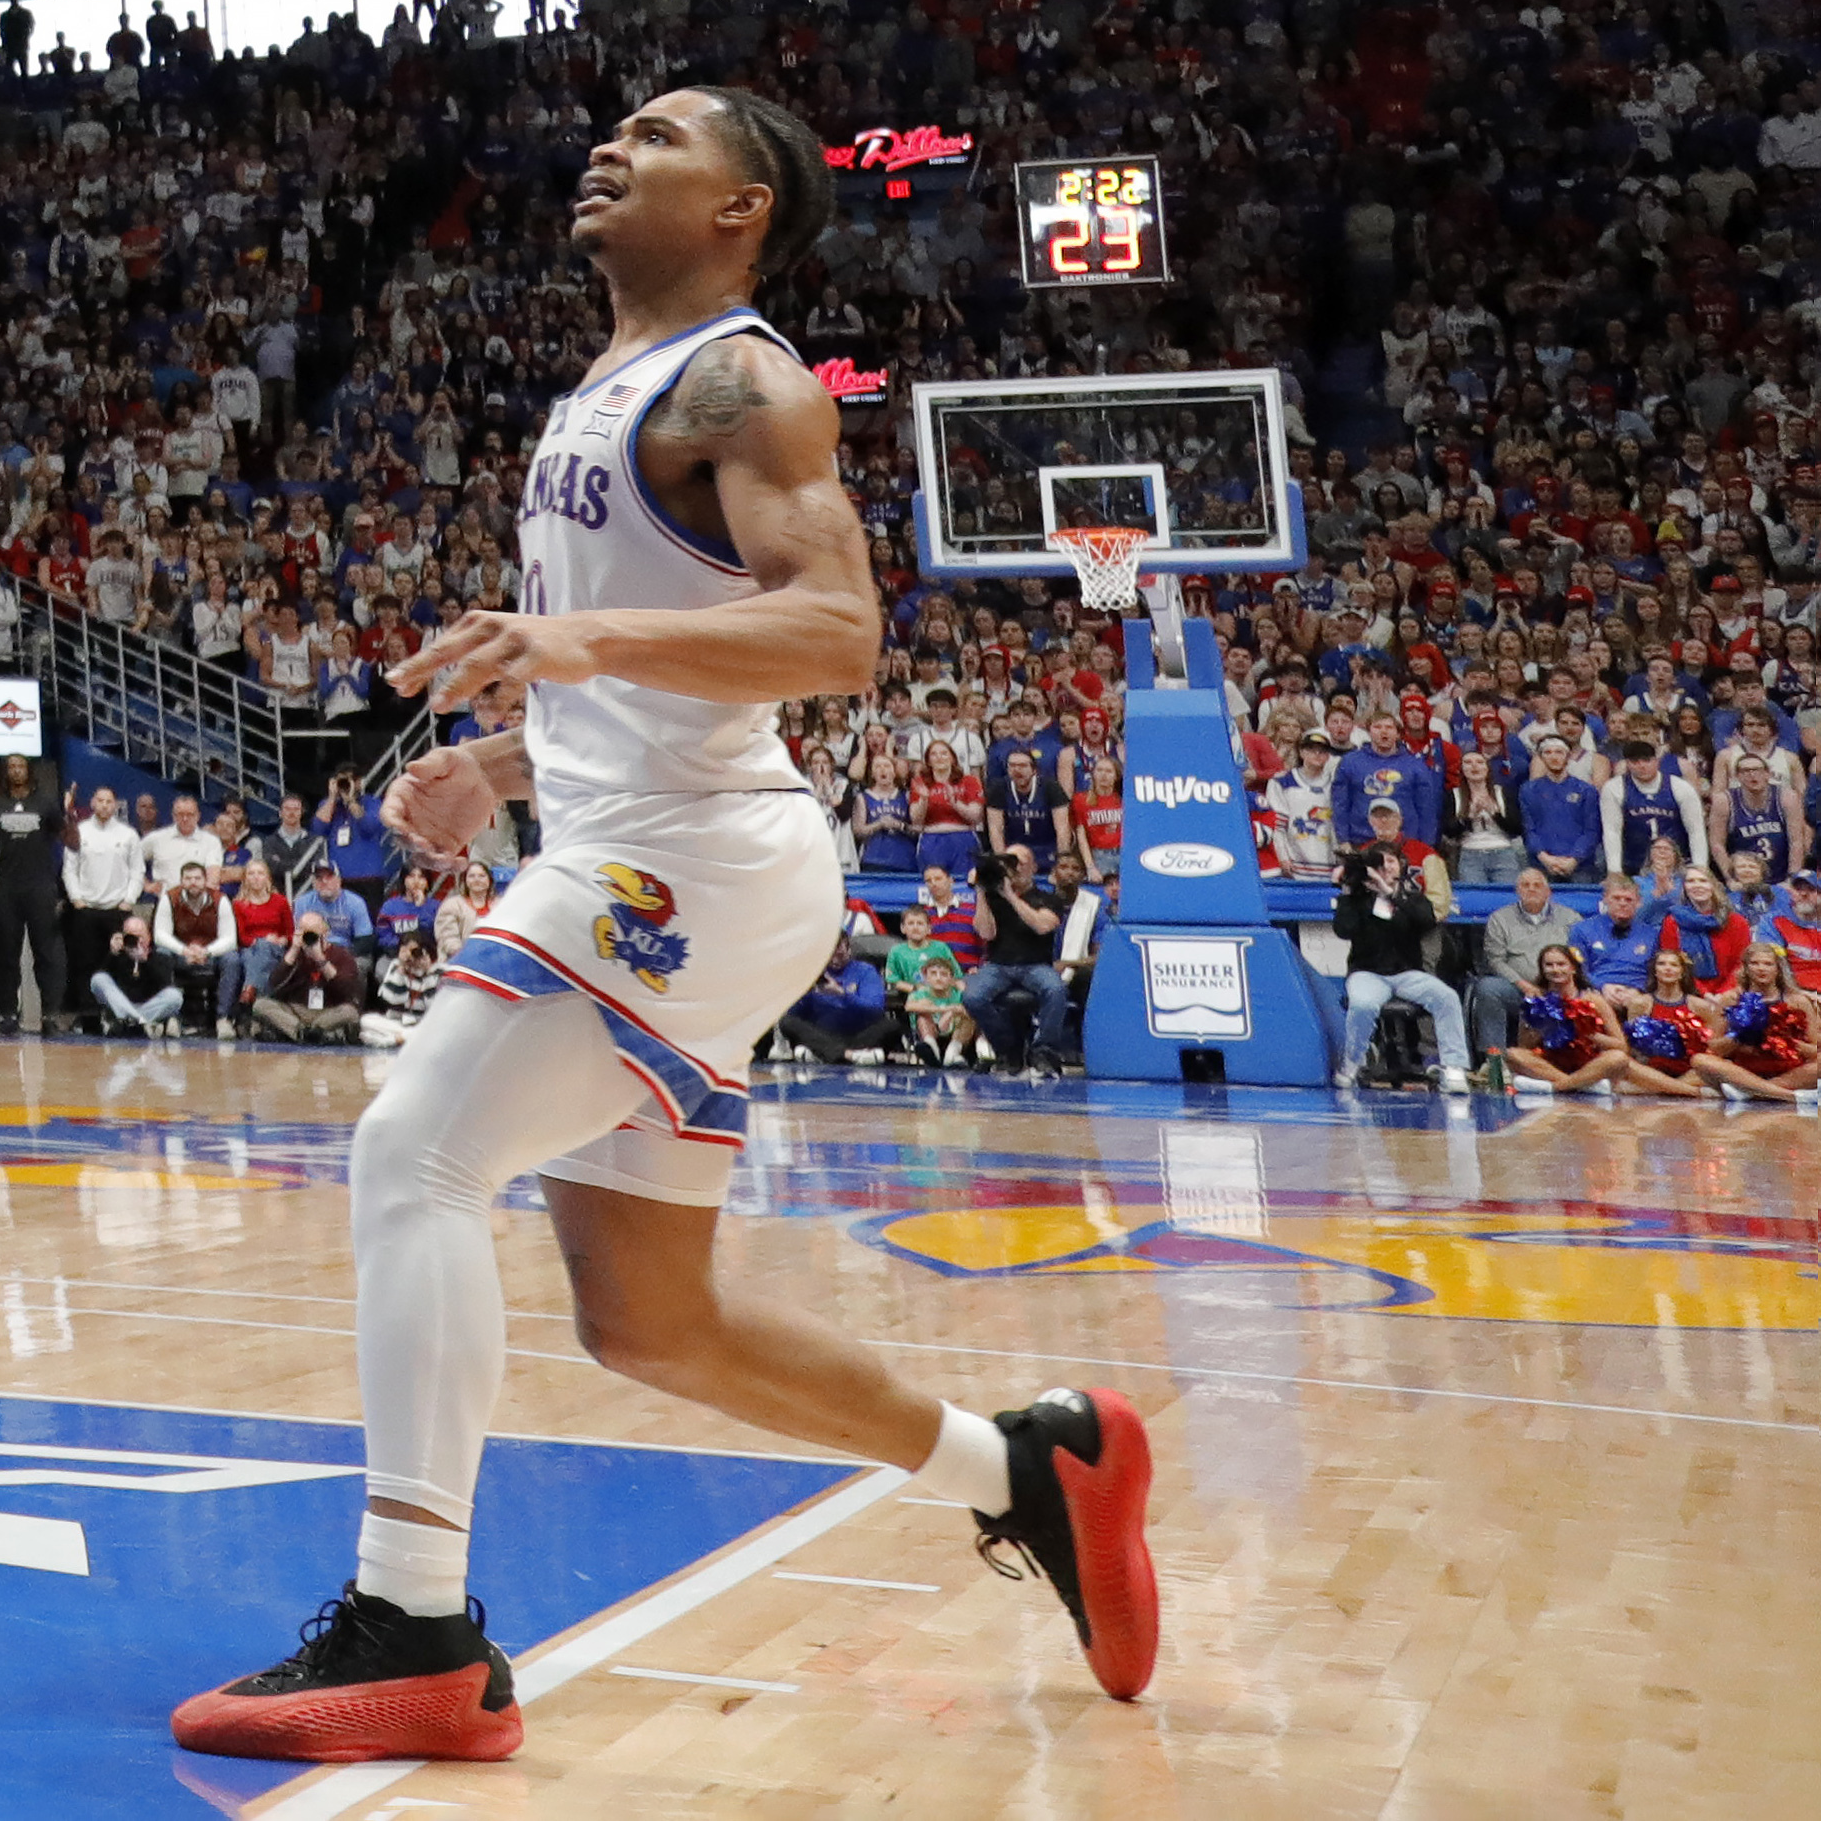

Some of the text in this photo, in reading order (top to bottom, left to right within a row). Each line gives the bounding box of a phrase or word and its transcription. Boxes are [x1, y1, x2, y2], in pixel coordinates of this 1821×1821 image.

[1057, 169, 1143, 207] 2:22
[1049, 207, 1142, 273] 23
[1158, 851, 1214, 871] Ford
[1154, 961, 1235, 979] SHELTER
[1155, 979, 1235, 991] INSURANCE
